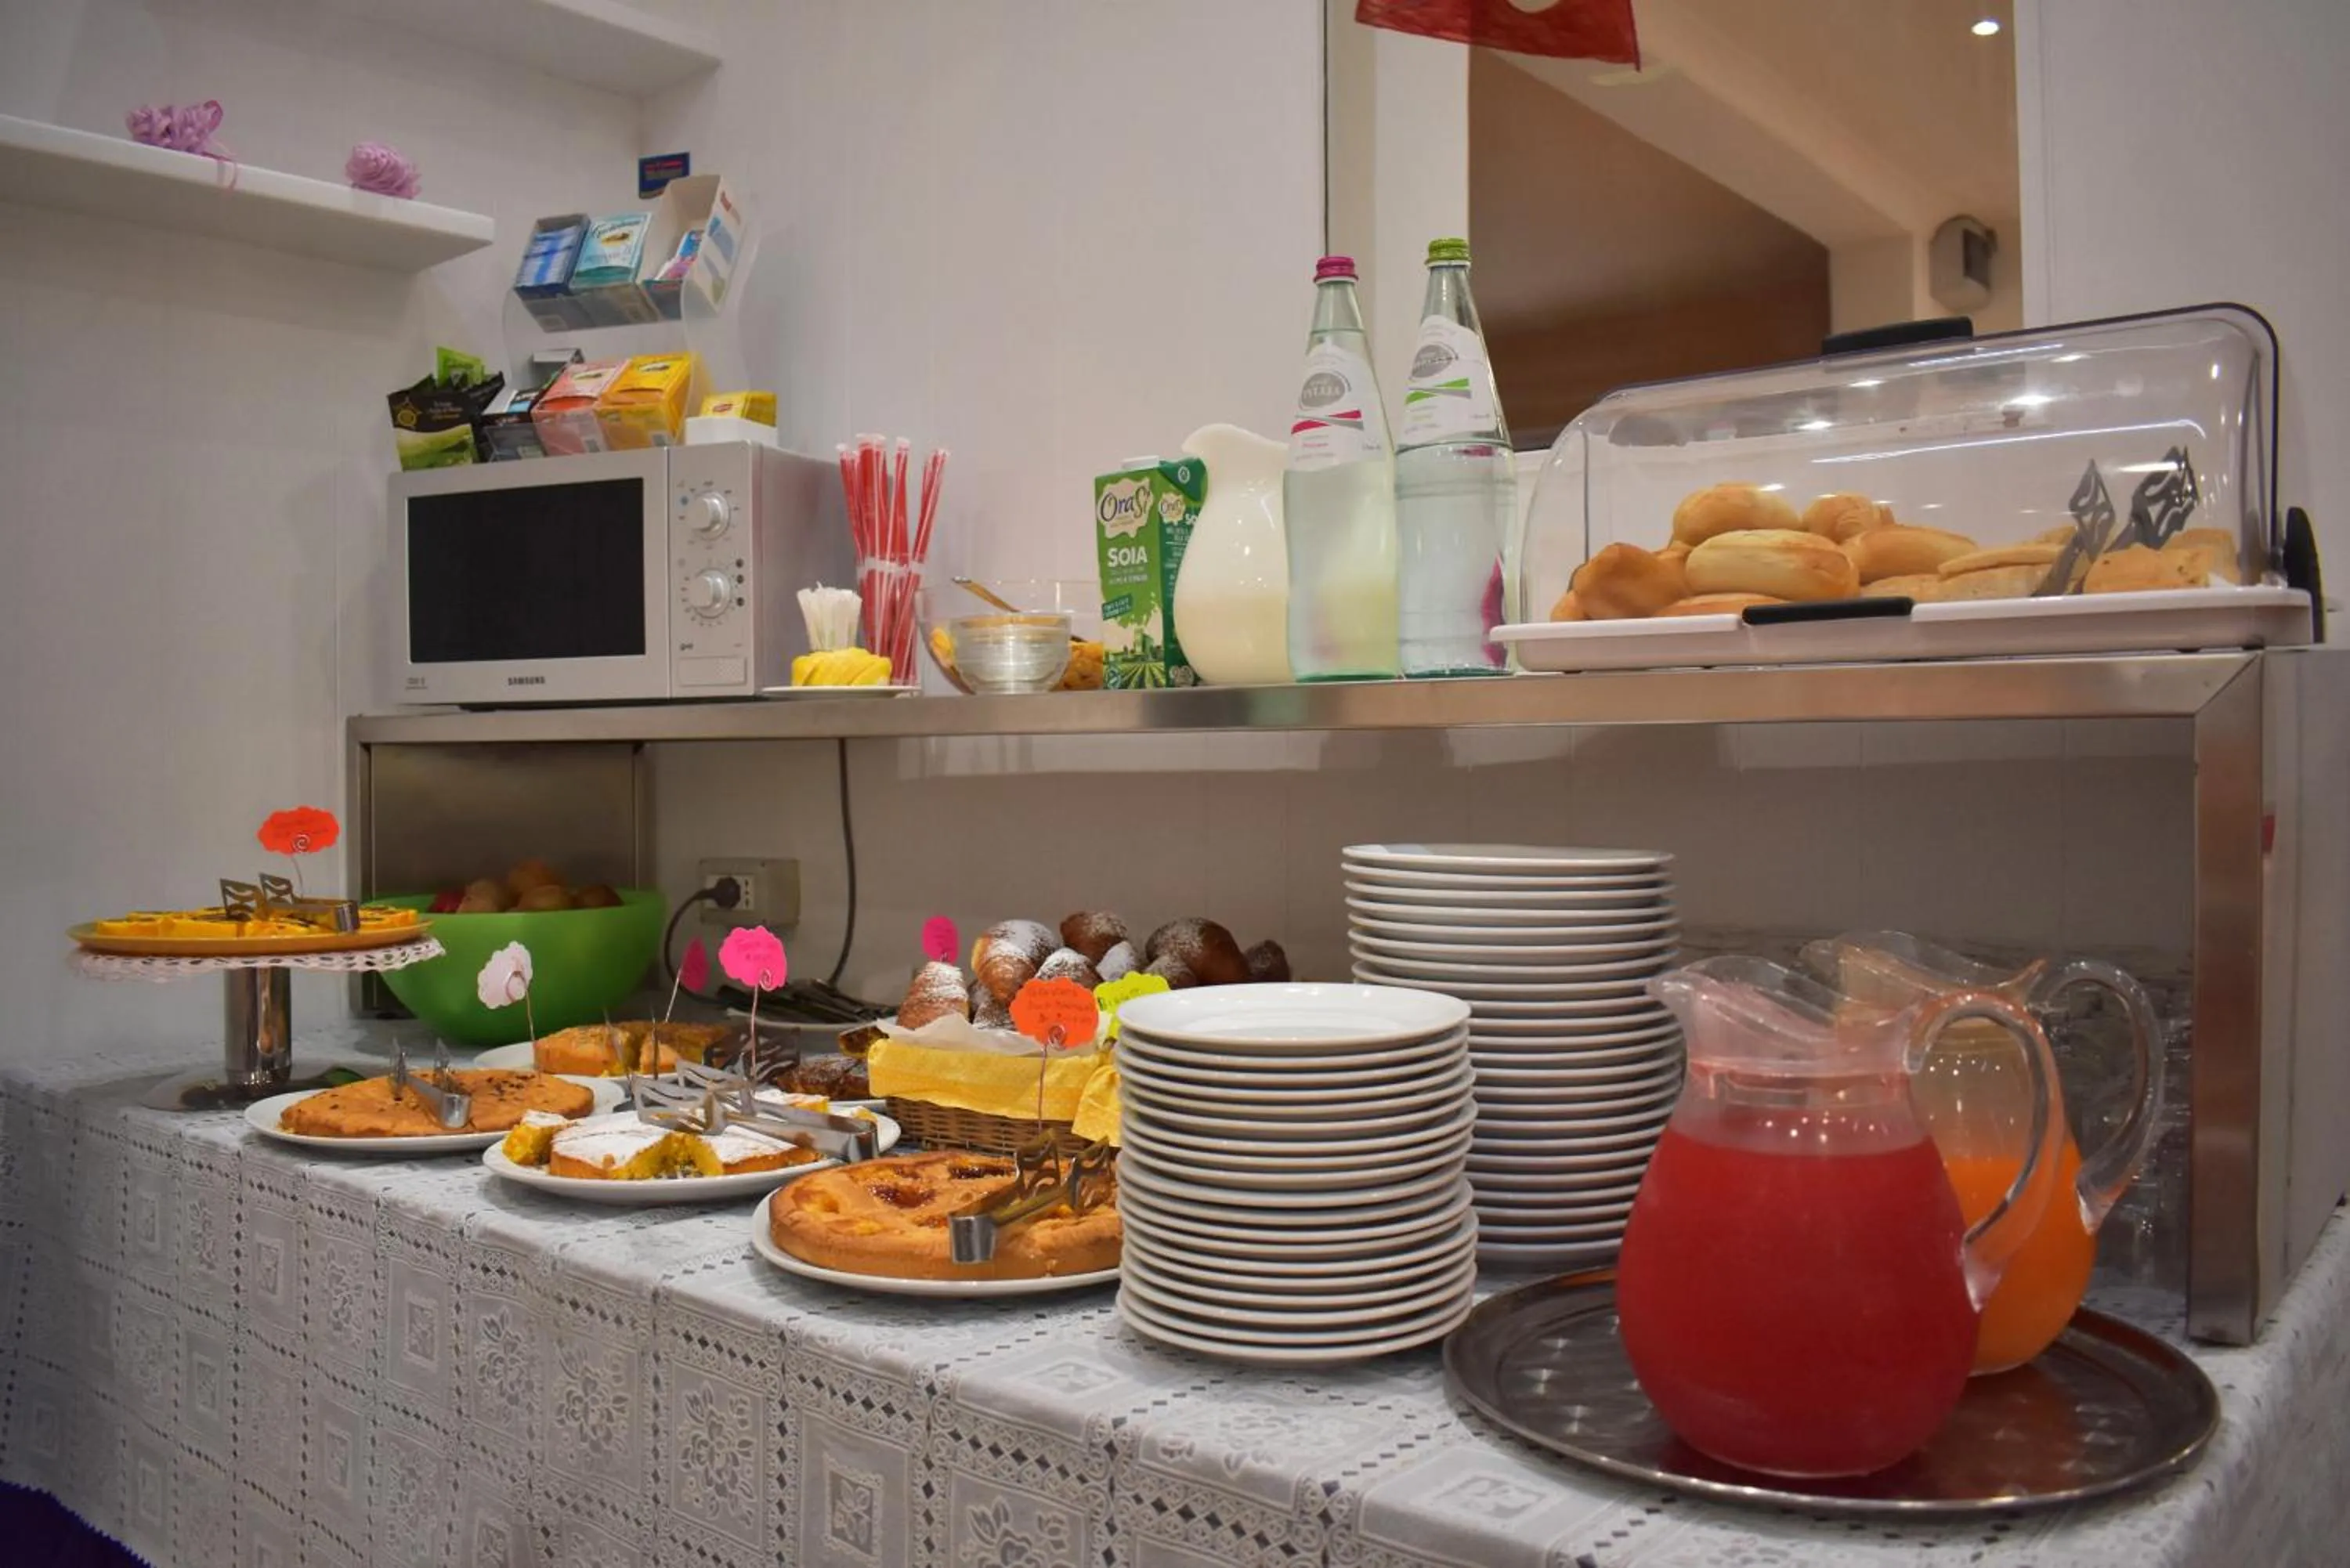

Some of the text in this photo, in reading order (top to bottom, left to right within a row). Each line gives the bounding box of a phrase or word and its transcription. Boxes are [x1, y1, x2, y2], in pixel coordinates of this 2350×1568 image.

[1100, 486, 1151, 522] OraSi
[1107, 546, 1148, 567] SOIA
[508, 676, 546, 686] SAMSUNG
